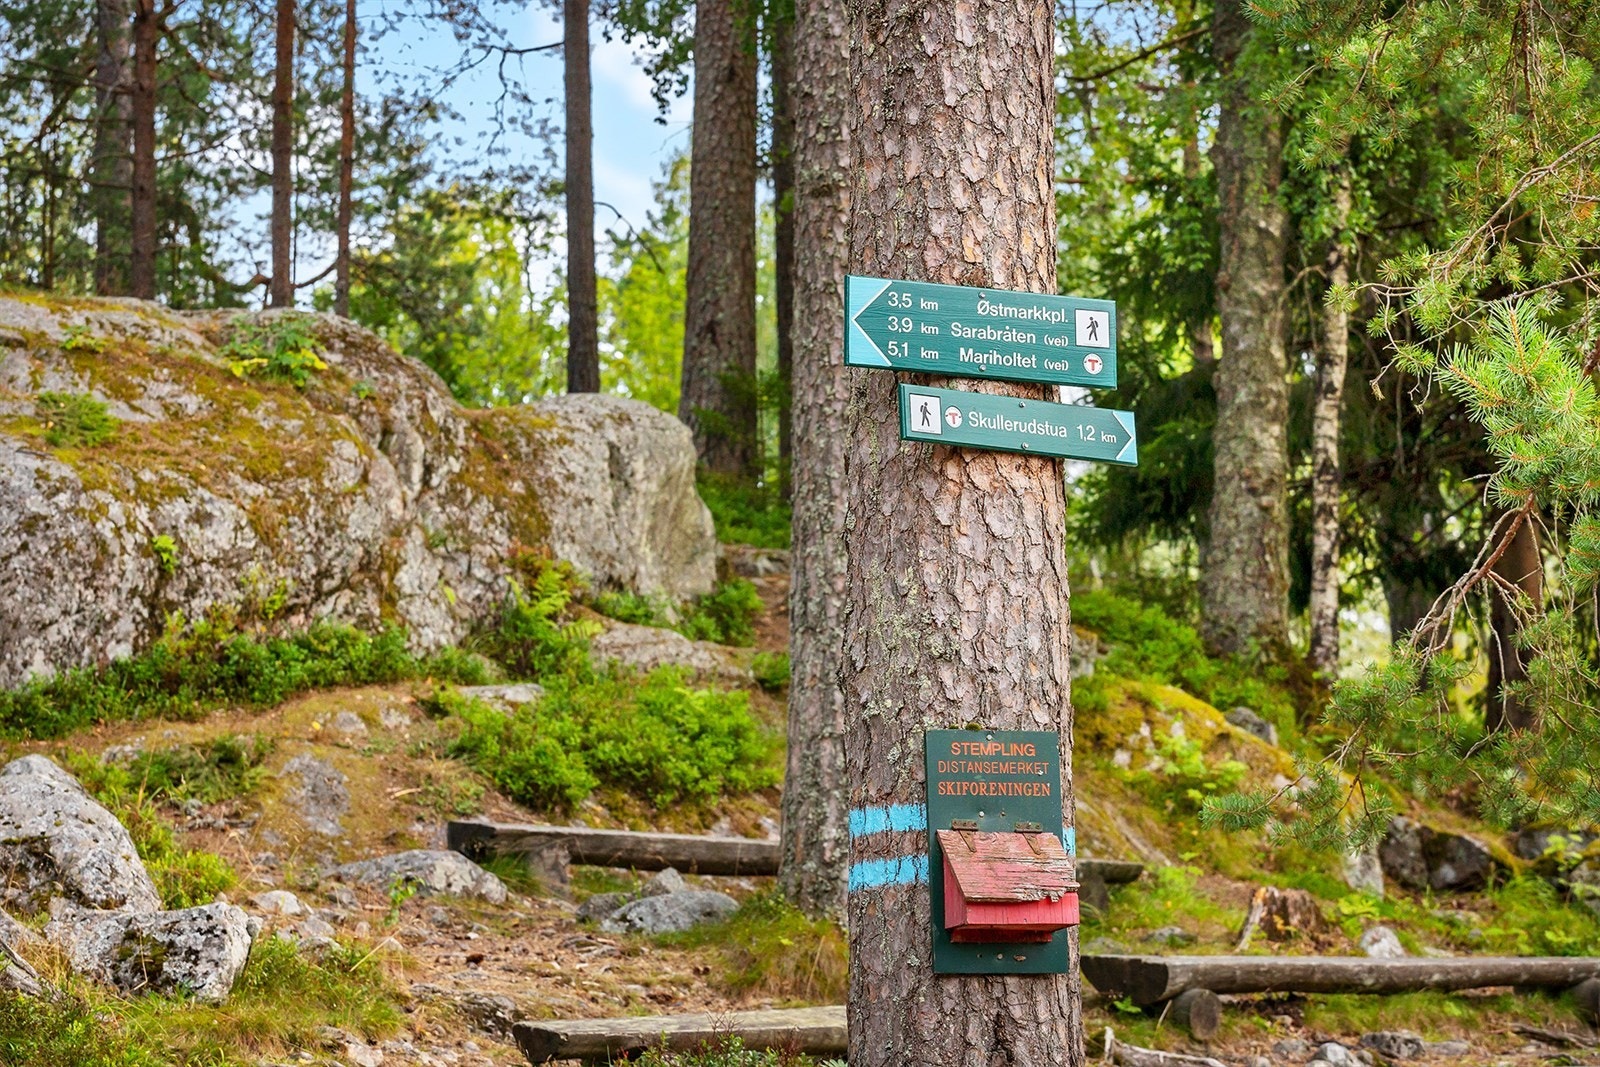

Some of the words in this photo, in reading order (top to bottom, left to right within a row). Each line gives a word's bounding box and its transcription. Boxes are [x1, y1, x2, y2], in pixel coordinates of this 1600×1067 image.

[887, 291, 912, 309] 3,5
[920, 298, 939, 311] km
[977, 300, 1069, 324] Østmarkkpl.
[887, 316, 913, 334] 3,9
[920, 322, 939, 336] km
[950, 323, 1036, 344] Sarabråten
[1043, 334, 1069, 347] (vei)
[887, 340, 909, 358] 5,1
[920, 347, 939, 360] km
[959, 347, 1037, 369] Mariholtet
[1043, 358, 1069, 371] (vei)
[968, 411, 1067, 438] Skullerudstua
[1076, 424, 1096, 442] 1,2
[1101, 430, 1117, 443] km
[951, 742, 1036, 756] STEMPLING
[938, 760, 1049, 774] DISTANSEMERKET
[938, 781, 1050, 797] SKIFORENINGEN
